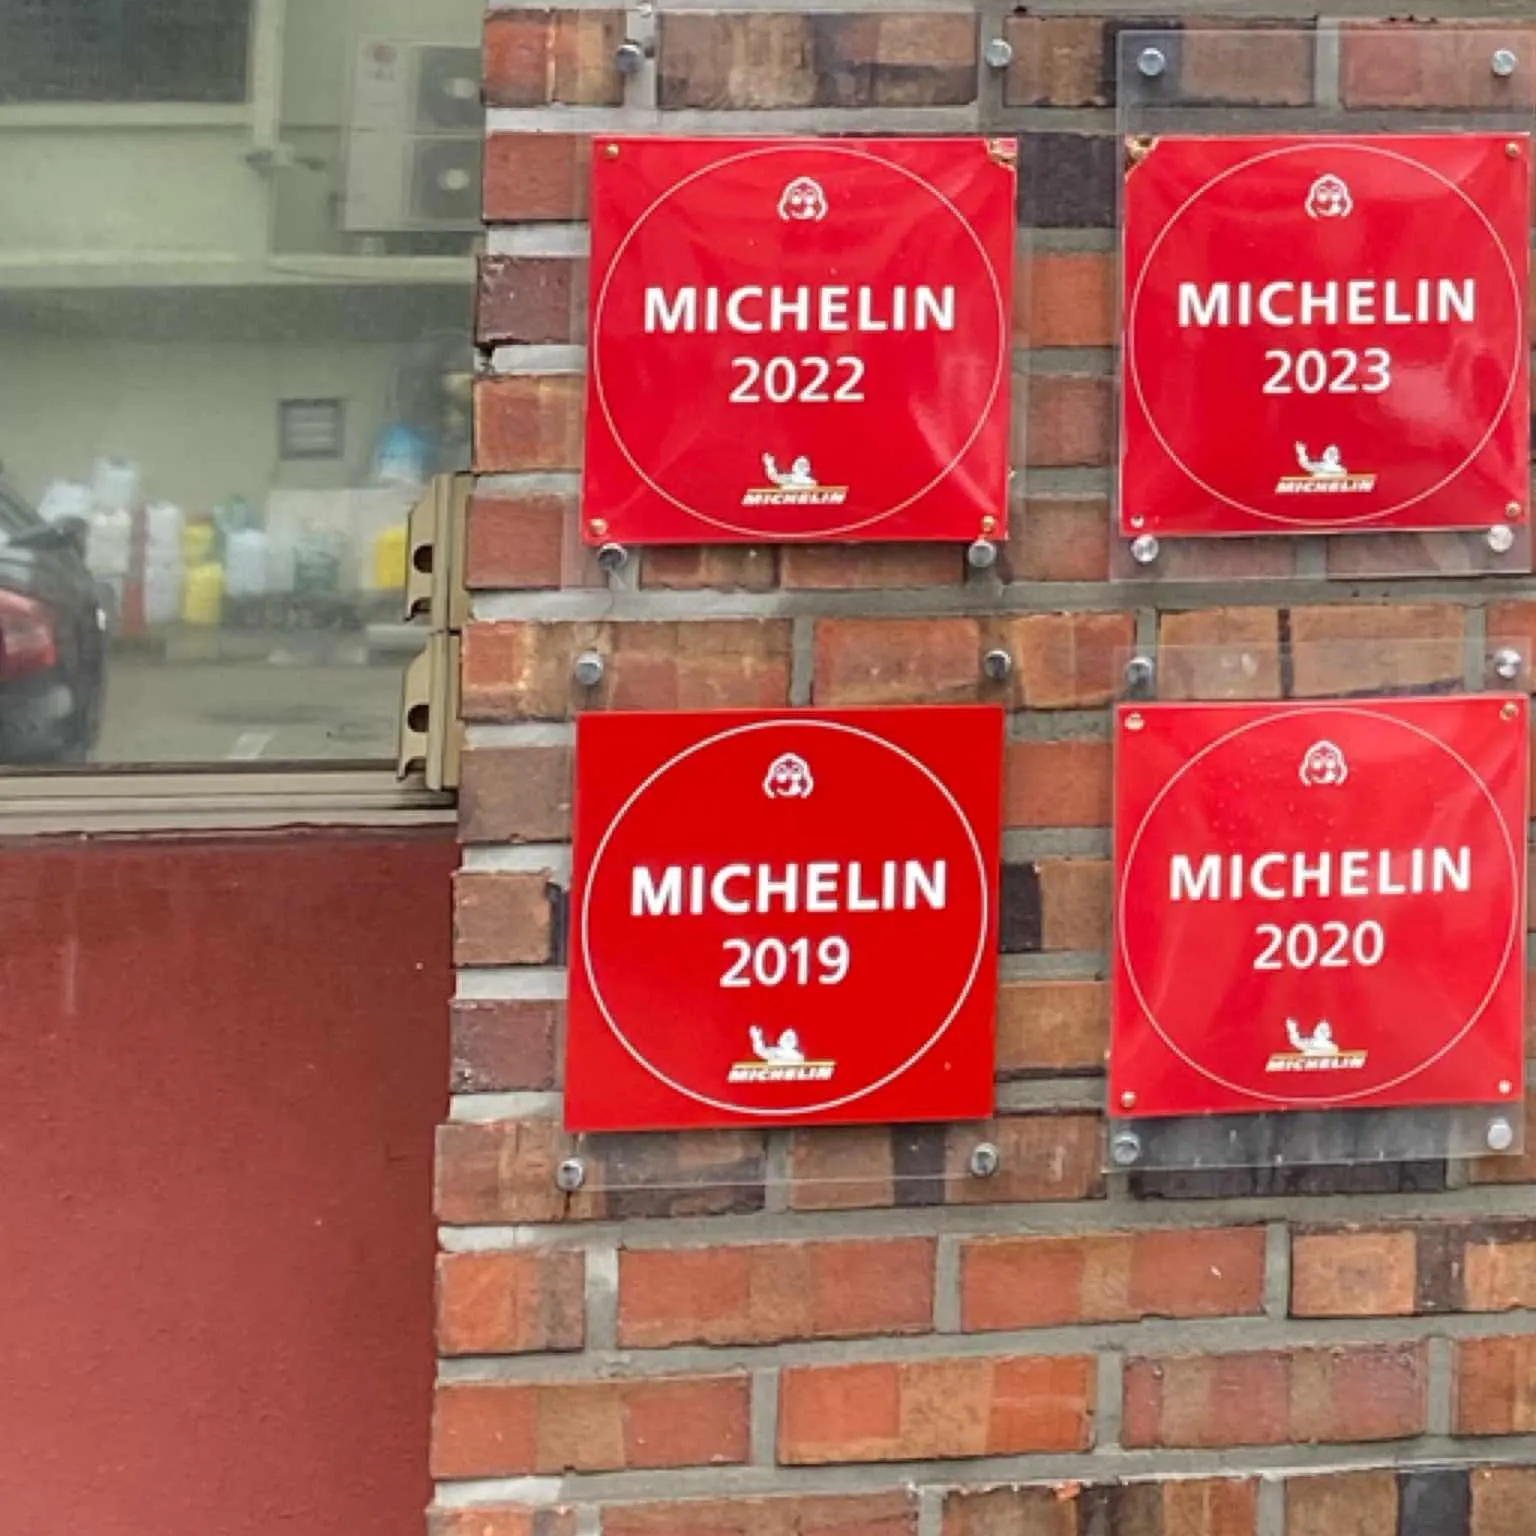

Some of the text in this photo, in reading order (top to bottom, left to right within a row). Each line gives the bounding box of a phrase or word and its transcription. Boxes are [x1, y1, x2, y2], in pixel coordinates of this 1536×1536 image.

[644, 285, 956, 333] MICHELIN
[1177, 278, 1477, 328] MICHELIN
[729, 356, 865, 403] 2022
[1262, 348, 1392, 394] 2023
[630, 860, 947, 916] MICHELIN
[1169, 846, 1471, 902] MICHELIN
[720, 935, 850, 988] 2019
[1253, 920, 1385, 971] 2020
